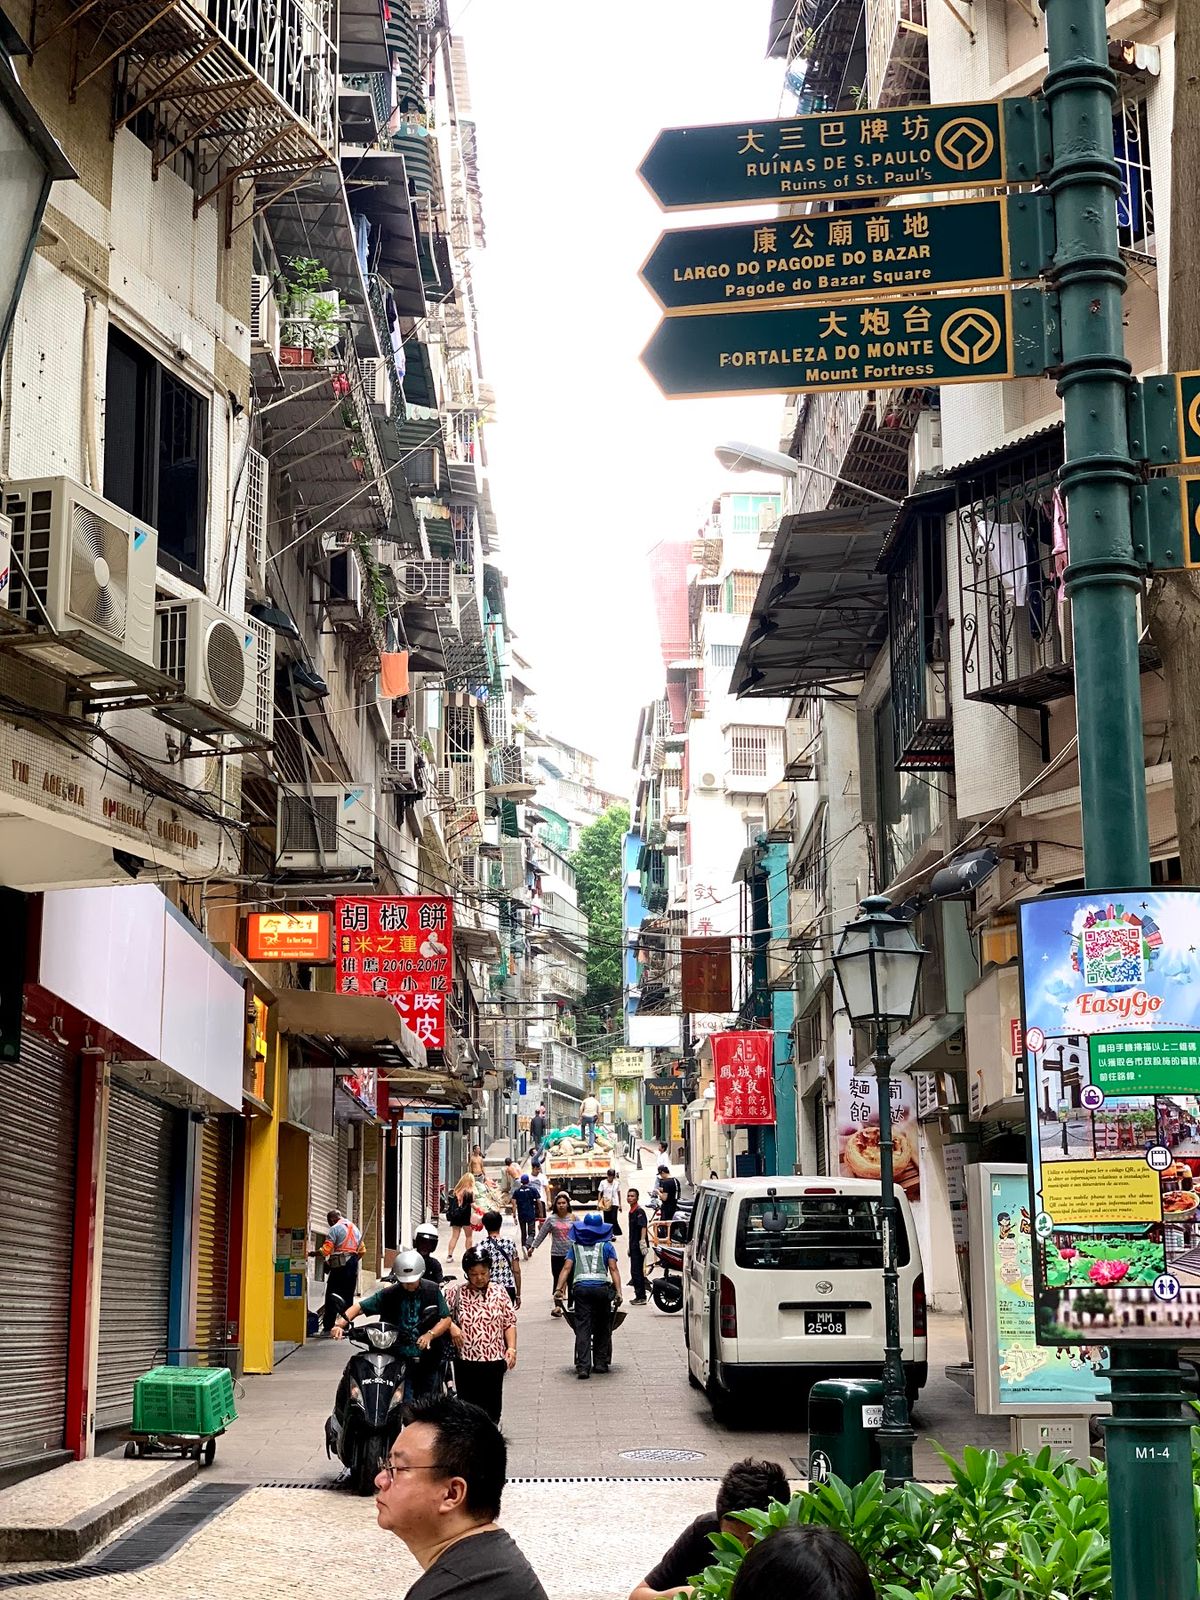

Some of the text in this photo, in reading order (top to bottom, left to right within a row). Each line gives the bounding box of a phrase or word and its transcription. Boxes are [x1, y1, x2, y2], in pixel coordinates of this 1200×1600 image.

[737, 115, 930, 154] 大三巴牌坊
[747, 149, 931, 176] RUÍNAS DE S.PAULO
[781, 167, 932, 191] Ruins of St. Paul's
[753, 211, 929, 254] 康公廟前地
[673, 245, 931, 282] LARGO DO PAGODE DO BAZAR
[725, 268, 932, 297] Pagode do Bazar Square
[818, 305, 932, 339] 大炮台
[720, 340, 934, 368] FORTALEZA DO MONTE
[806, 364, 934, 382] Mount Fortress
[341, 904, 447, 931] 胡椒餅
[355, 935, 417, 954] 米之蓮
[342, 957, 448, 973] 推薦 2016-2017
[342, 976, 449, 992] 美食小吃
[1076, 991, 1164, 1019] EasyGo
[808, 1322, 843, 1333] 25-08
[817, 1312, 833, 1322] MM
[1135, 1447, 1170, 1459] M1-4
